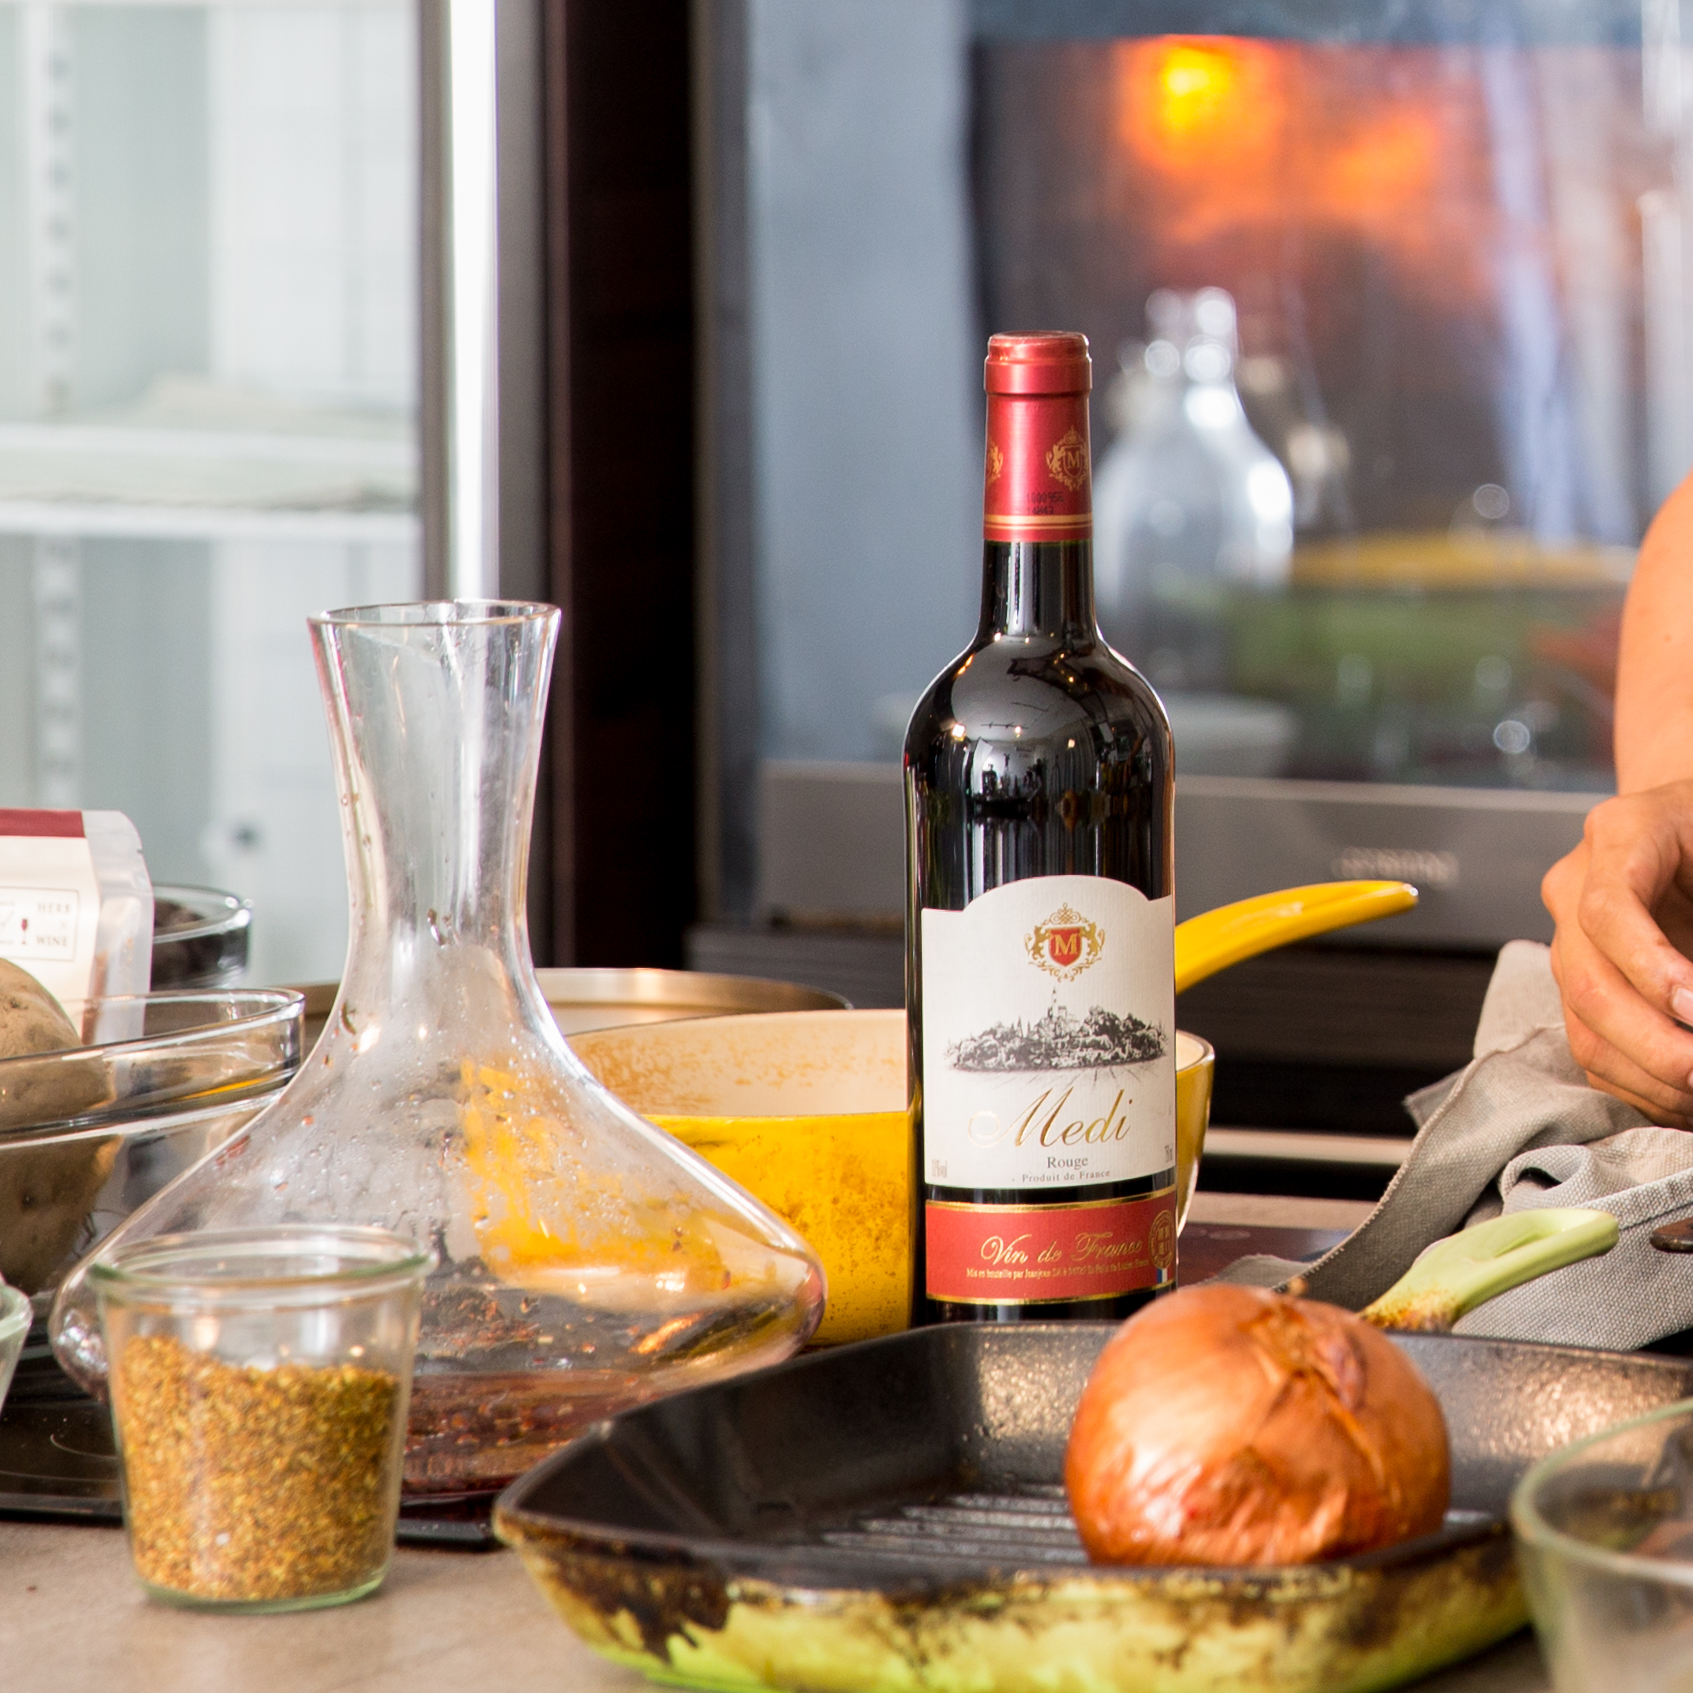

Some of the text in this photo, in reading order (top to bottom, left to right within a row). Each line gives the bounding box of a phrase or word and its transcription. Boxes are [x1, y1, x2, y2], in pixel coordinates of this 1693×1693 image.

[1067, 451, 1080, 468] M
[38, 903, 70, 913] HERB
[37, 936, 68, 946] WINE
[1054, 934, 1078, 955] M
[967, 1086, 1134, 1148] Medi
[1047, 1156, 1089, 1170] Rouge
[1022, 1170, 1111, 1183] Produit de France
[980, 1233, 1032, 1265] Vin
[1037, 1241, 1062, 1263] de
[1071, 1231, 1143, 1262] France
[1013, 1270, 1024, 1280] par
